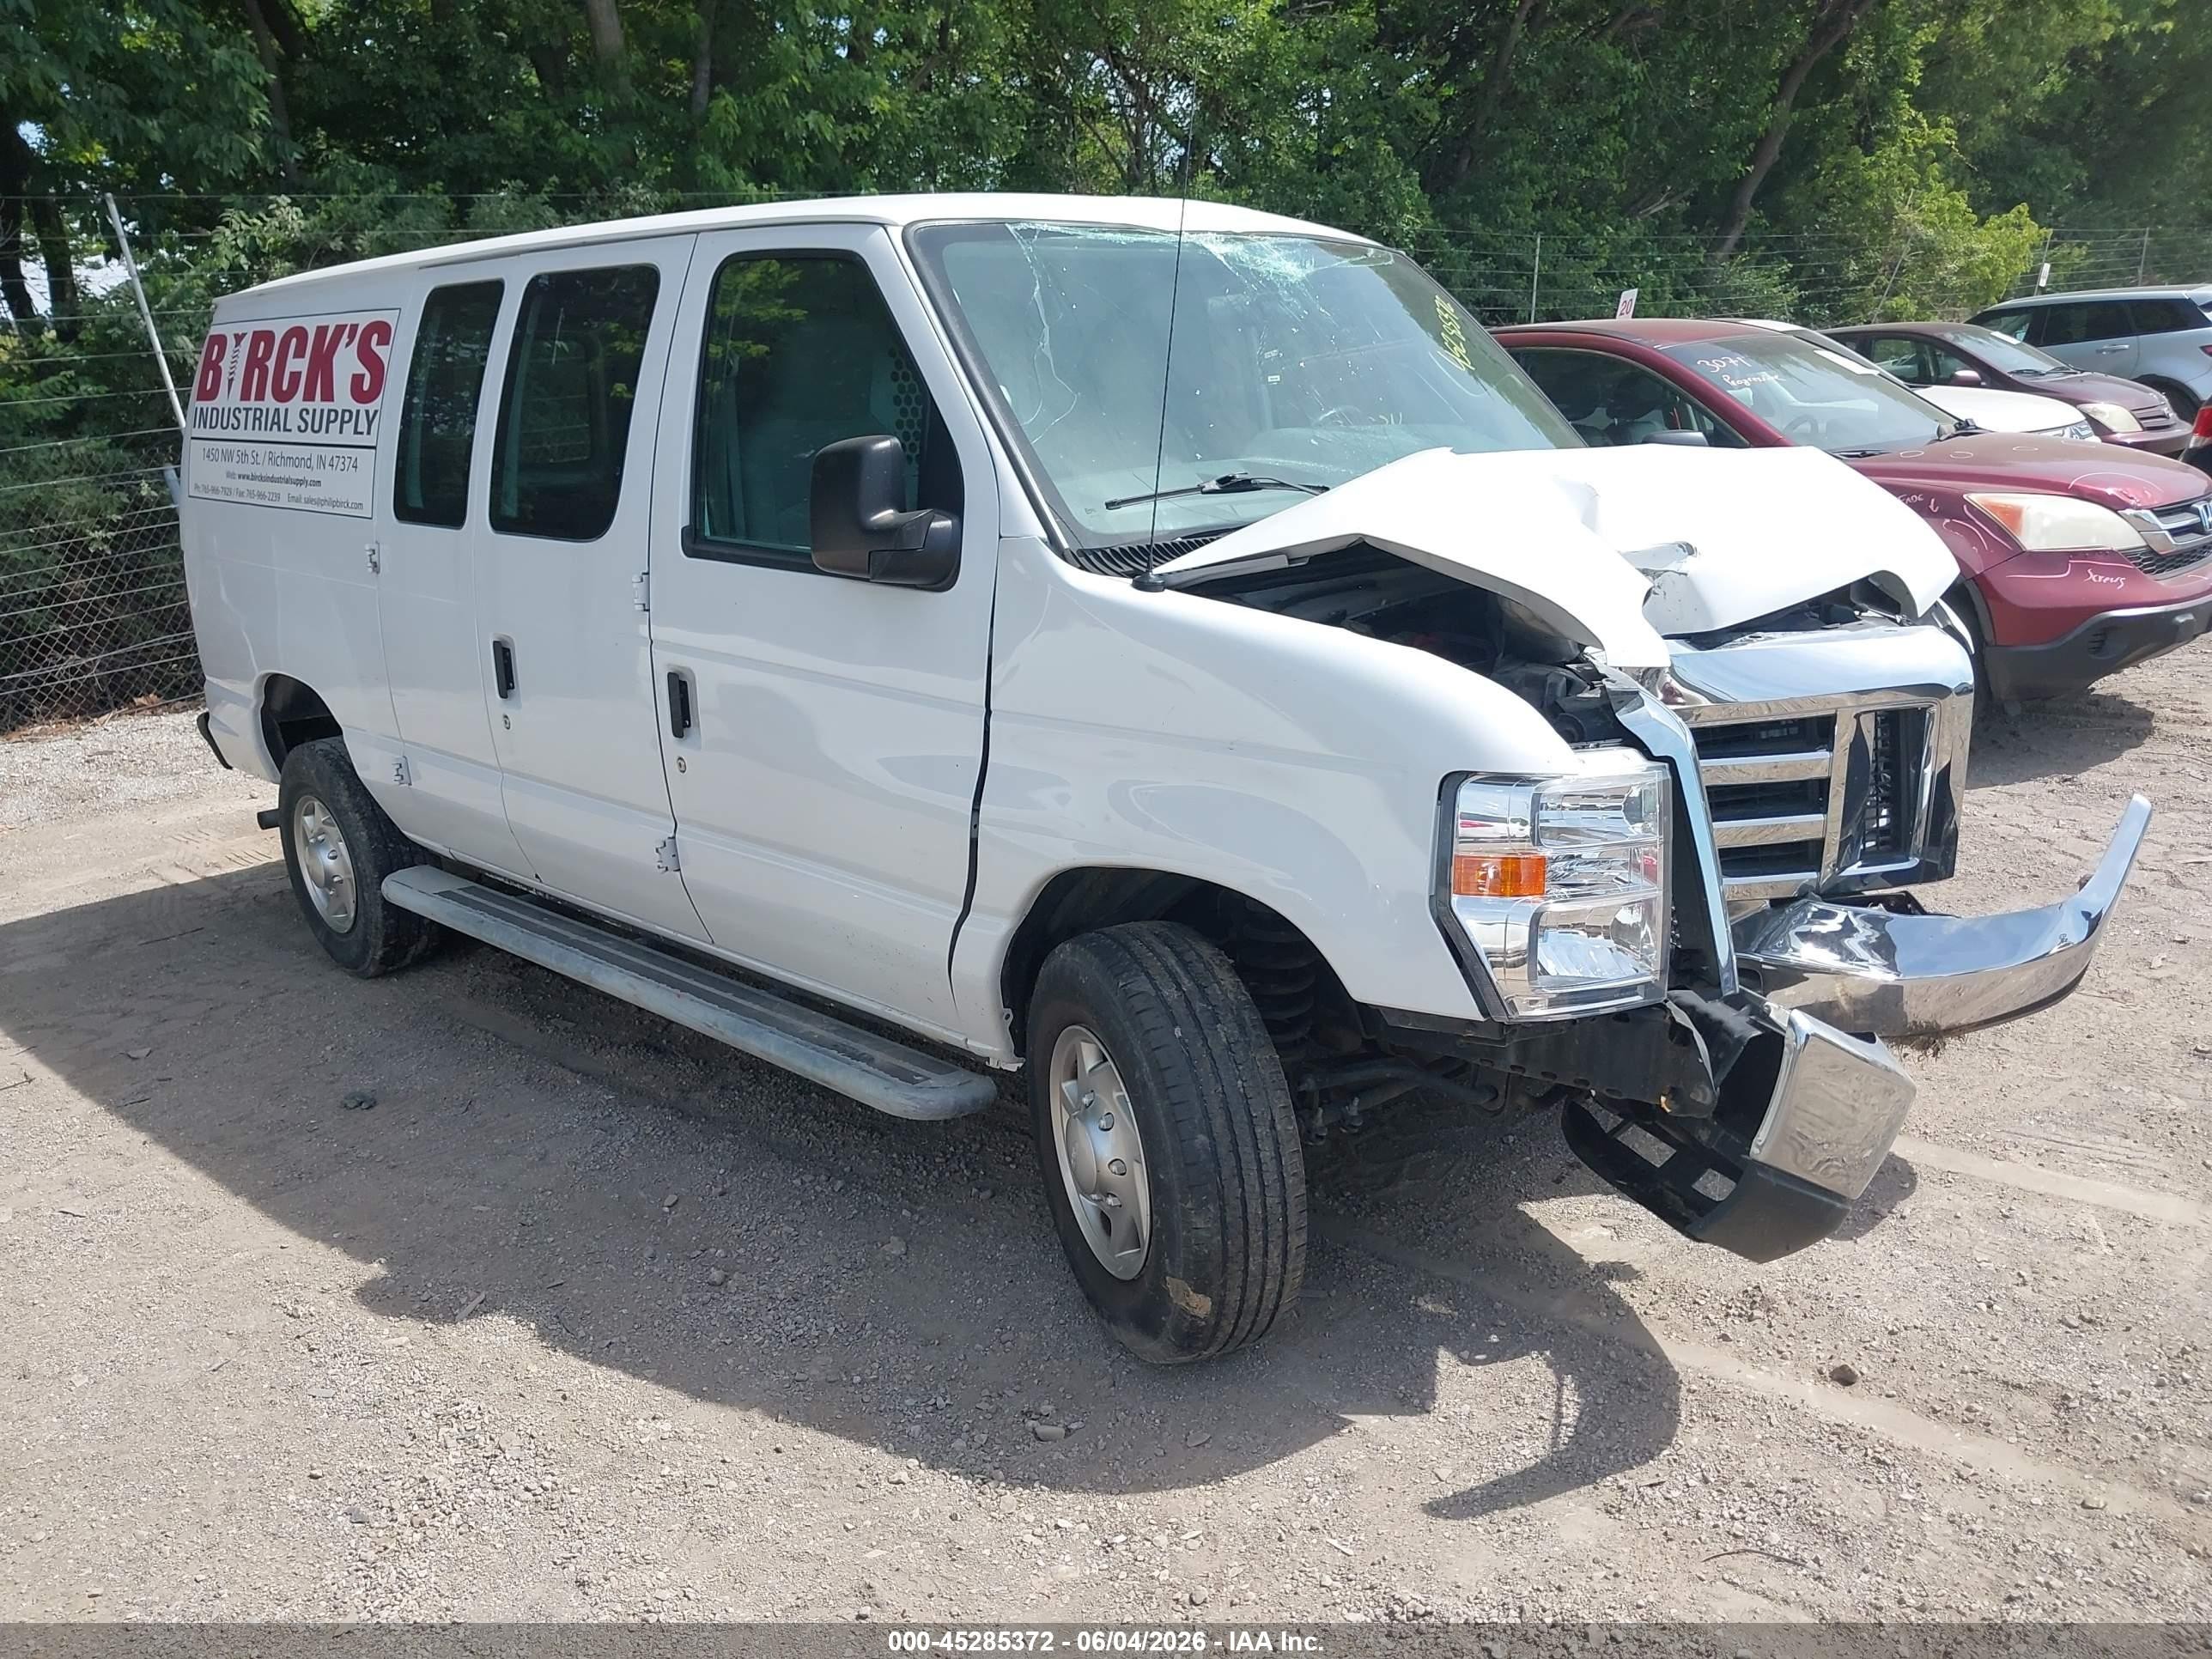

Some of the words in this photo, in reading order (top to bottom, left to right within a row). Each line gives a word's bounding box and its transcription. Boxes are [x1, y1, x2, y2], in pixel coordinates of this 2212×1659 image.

[1619, 298, 1633, 317] 20
[1696, 356, 1753, 374] 3071
[192, 406, 293, 433] INDUSTRIAL
[296, 408, 379, 436] SUPPLY
[202, 447, 220, 462] 1450
[221, 447, 235, 464] NW
[235, 448, 249, 465] 5th
[251, 450, 261, 465] St.
[262, 450, 267, 466] /
[268, 450, 314, 471] Richmond,
[316, 453, 326, 471] IN
[327, 454, 359, 473] 47374
[238, 472, 322, 489] www.bircksindustrialsupply.com
